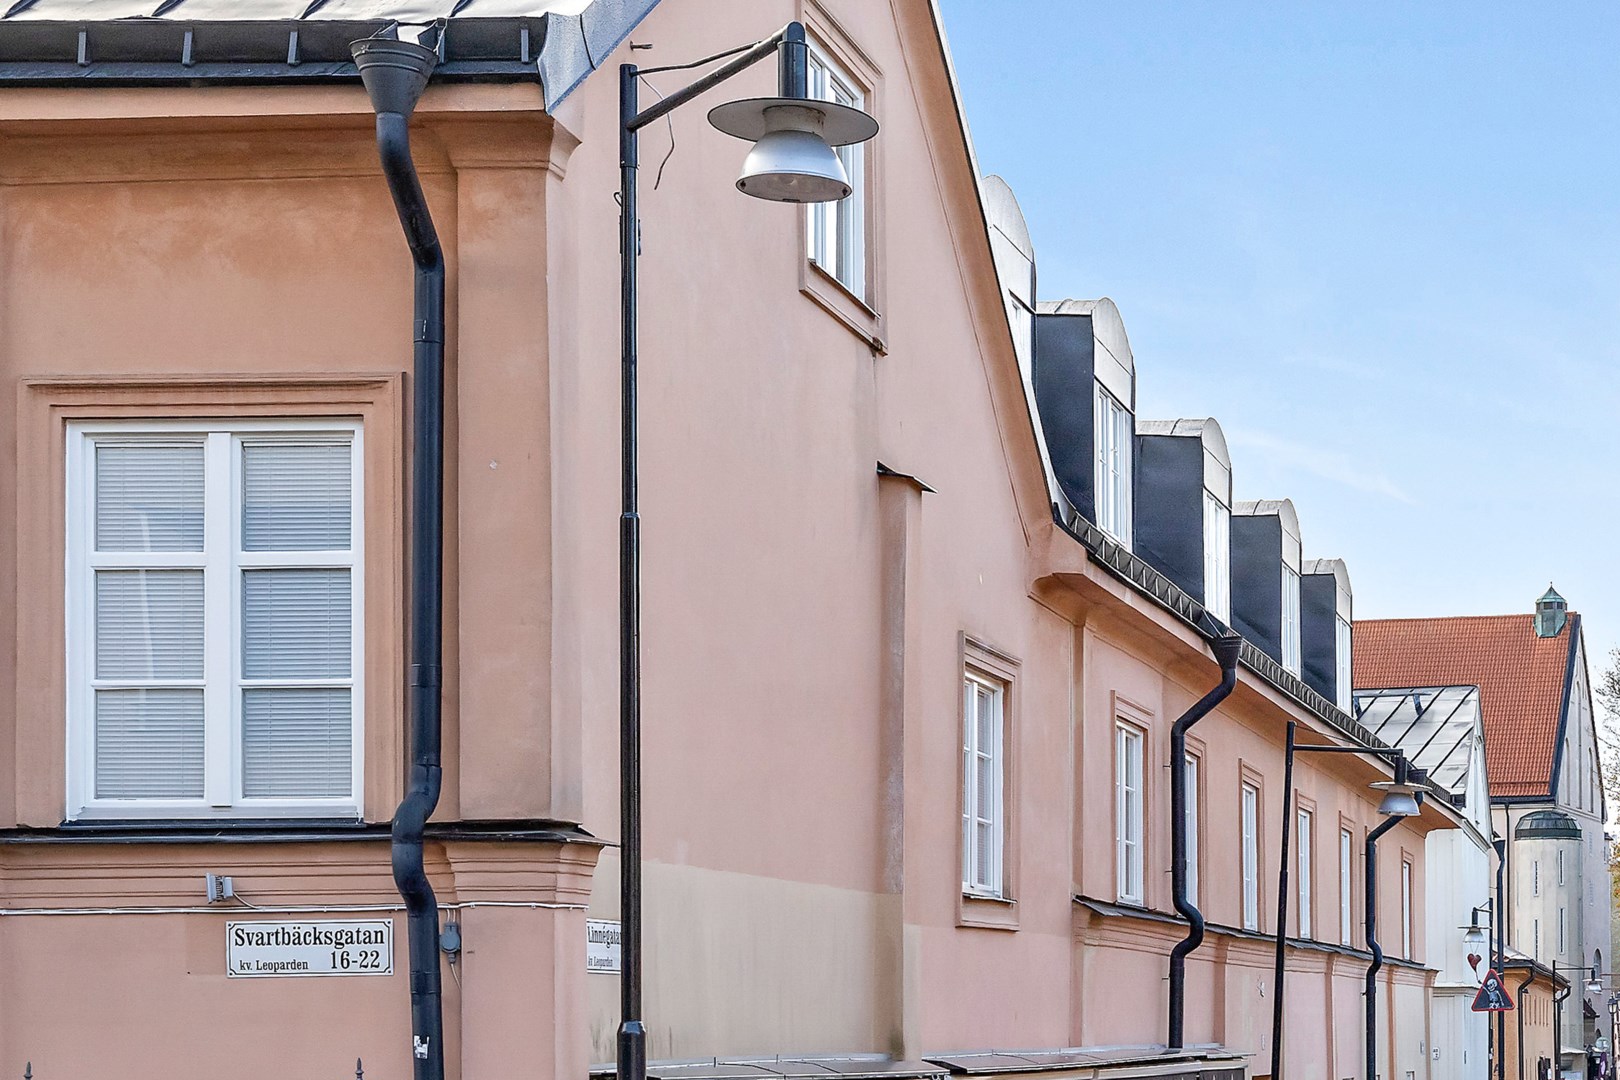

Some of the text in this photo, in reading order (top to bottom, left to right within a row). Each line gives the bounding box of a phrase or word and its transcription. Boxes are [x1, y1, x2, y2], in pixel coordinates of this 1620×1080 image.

[235, 926, 385, 949] Svartbäcksgatan
[587, 925, 622, 948] Linnégata
[240, 959, 308, 973] kv. Leoparden
[331, 950, 381, 969] 16-22
